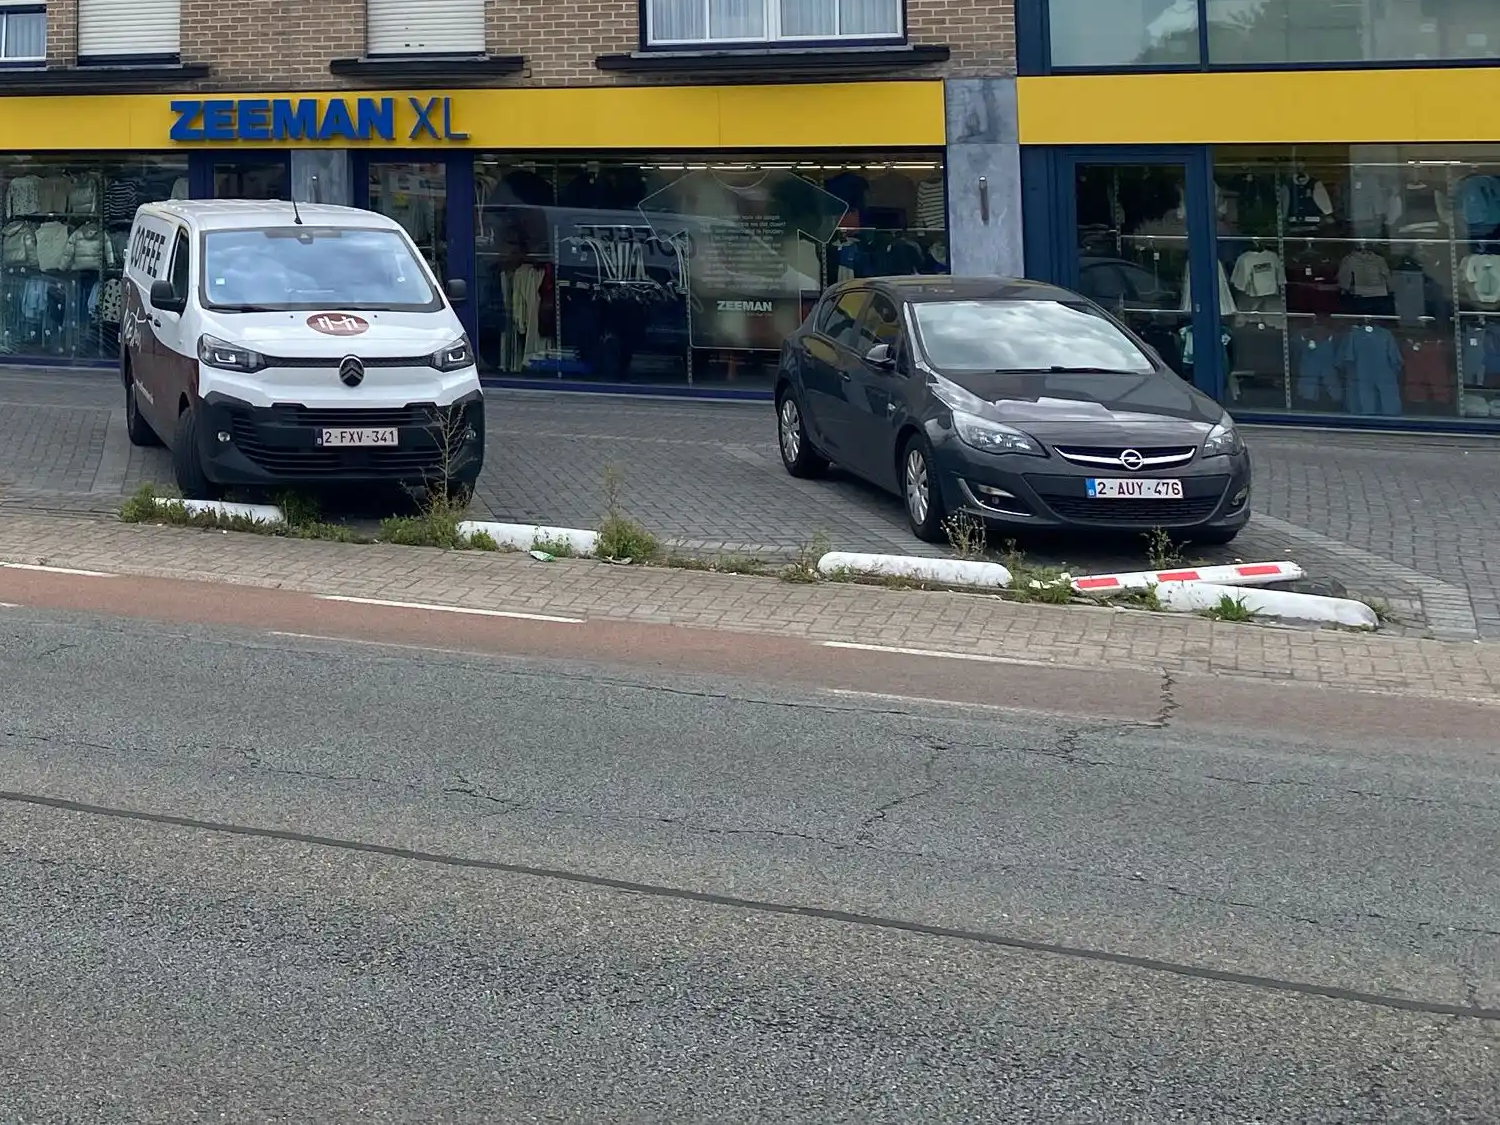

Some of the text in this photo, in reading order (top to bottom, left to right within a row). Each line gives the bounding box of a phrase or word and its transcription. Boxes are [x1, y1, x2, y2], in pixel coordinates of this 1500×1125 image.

[169, 97, 470, 141] ZEEMAN XL
[130, 225, 167, 279] COFFEE
[717, 300, 772, 312] ZEEMAN
[324, 430, 395, 443] 2-FXV-341
[1097, 481, 1181, 495] 2-AUY-476
